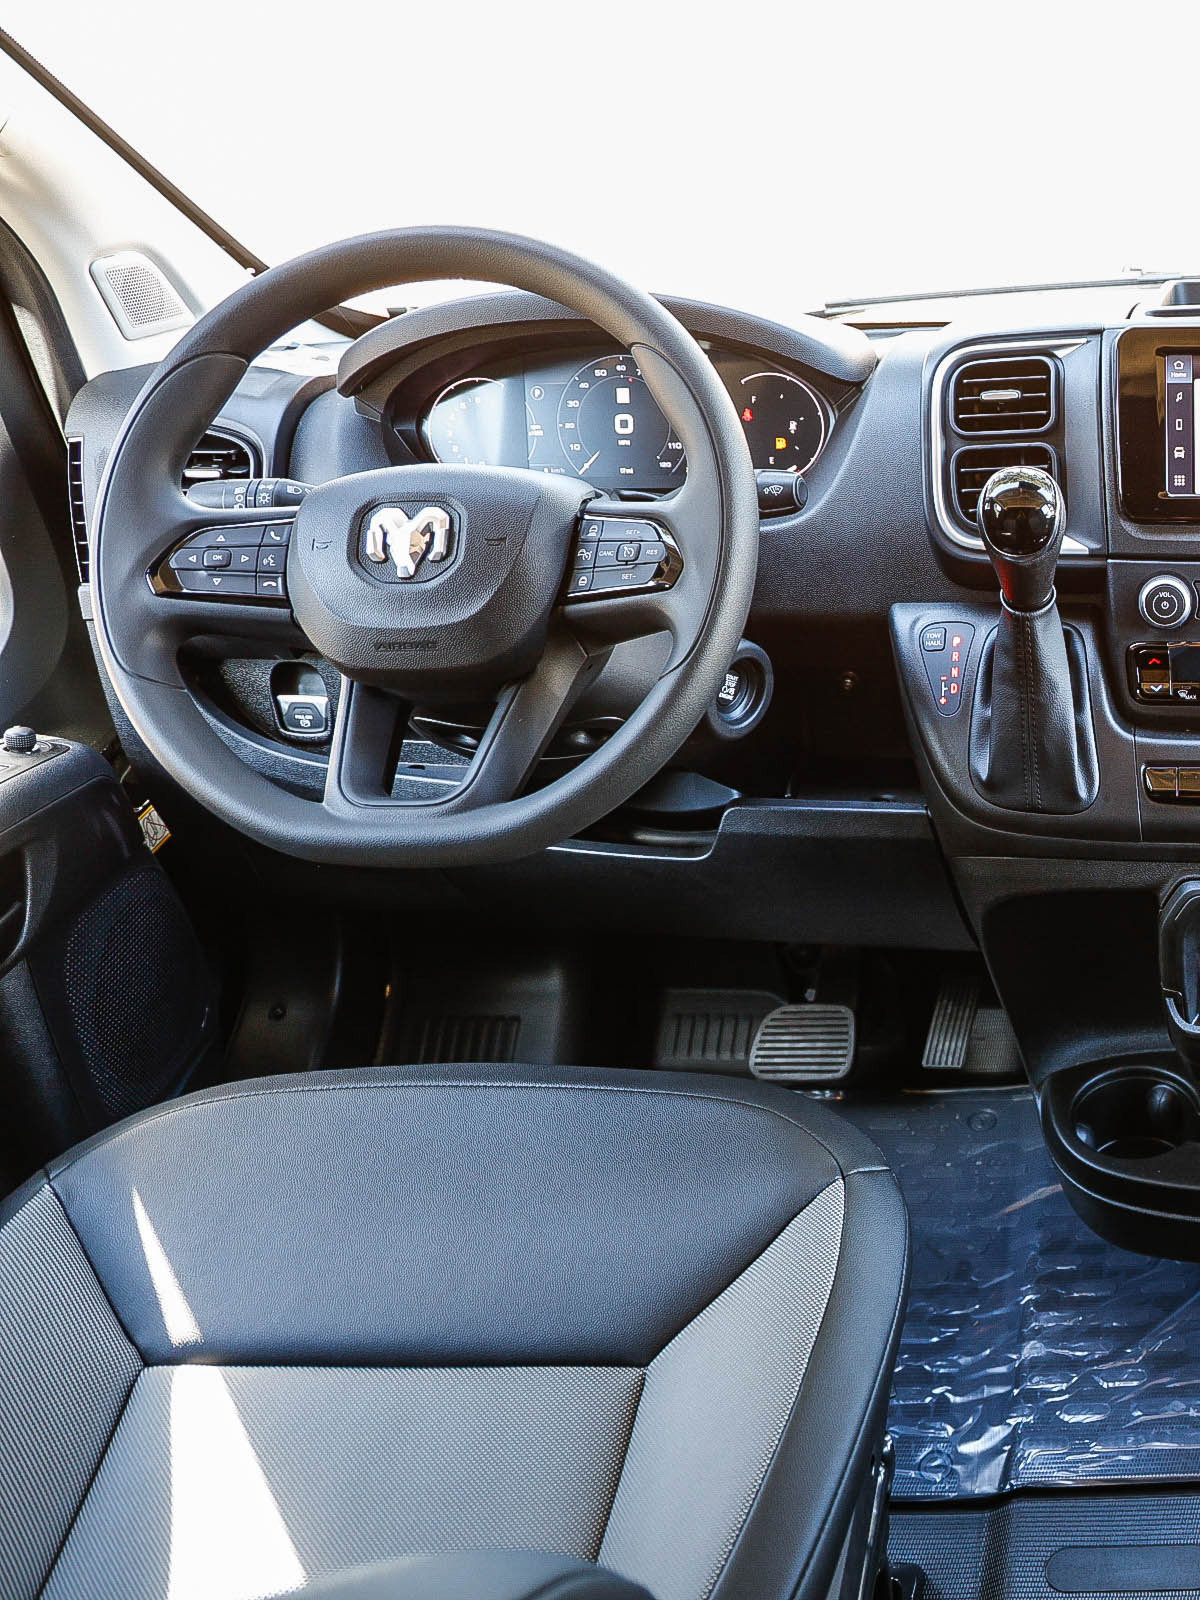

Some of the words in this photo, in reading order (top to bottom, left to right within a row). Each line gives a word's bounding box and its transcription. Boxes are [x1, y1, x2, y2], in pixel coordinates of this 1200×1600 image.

[594, 368, 608, 377] 50
[566, 400, 580, 408] 30
[751, 395, 757, 404] F
[614, 413, 634, 435] 0
[569, 443, 581, 451] 10
[667, 441, 683, 450] 110
[769, 456, 775, 465] E
[926, 632, 942, 640] TOW
[952, 636, 961, 647] P
[951, 651, 960, 662] R
[951, 666, 960, 678] N
[950, 682, 959, 695] D
